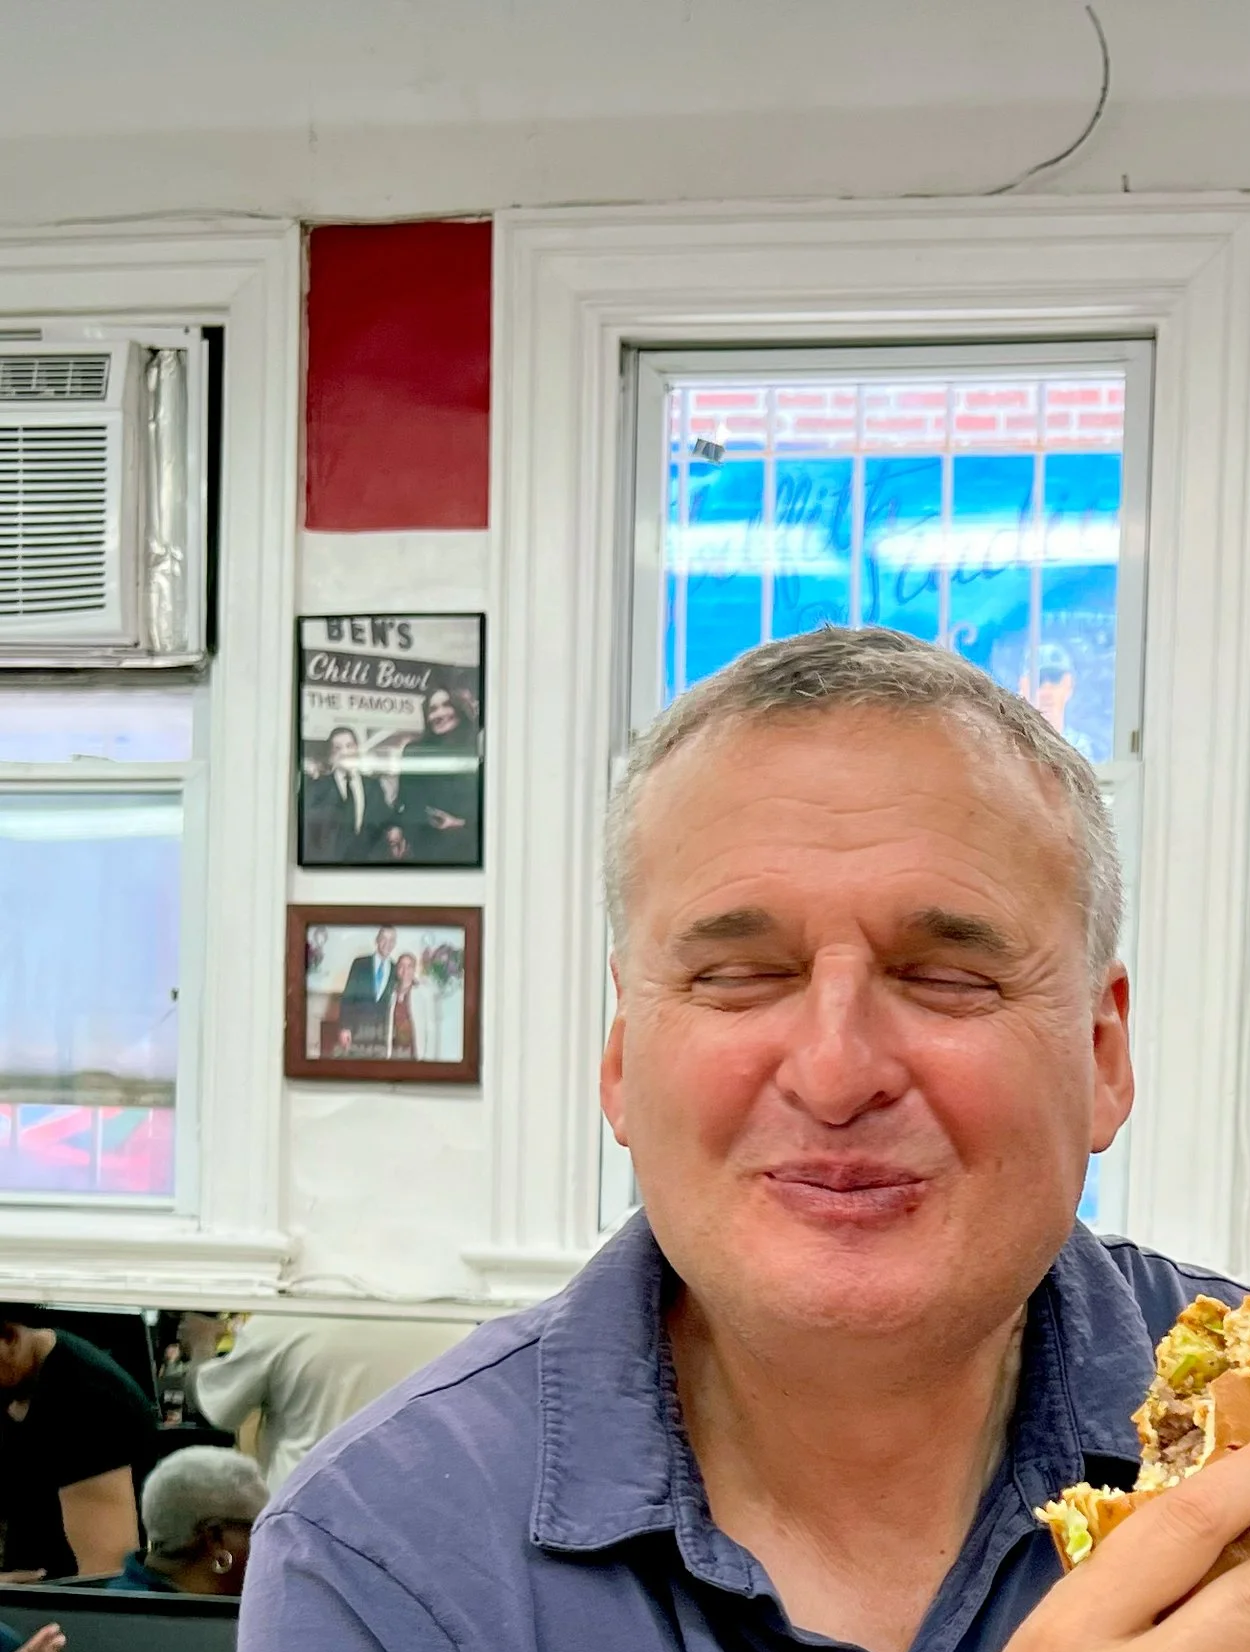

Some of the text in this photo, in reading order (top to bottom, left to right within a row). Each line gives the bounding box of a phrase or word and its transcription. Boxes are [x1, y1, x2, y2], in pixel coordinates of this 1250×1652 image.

[327, 617, 413, 649] BEN'S
[308, 652, 431, 691] Chili Bowl
[308, 691, 415, 713] THE FAMOUS
